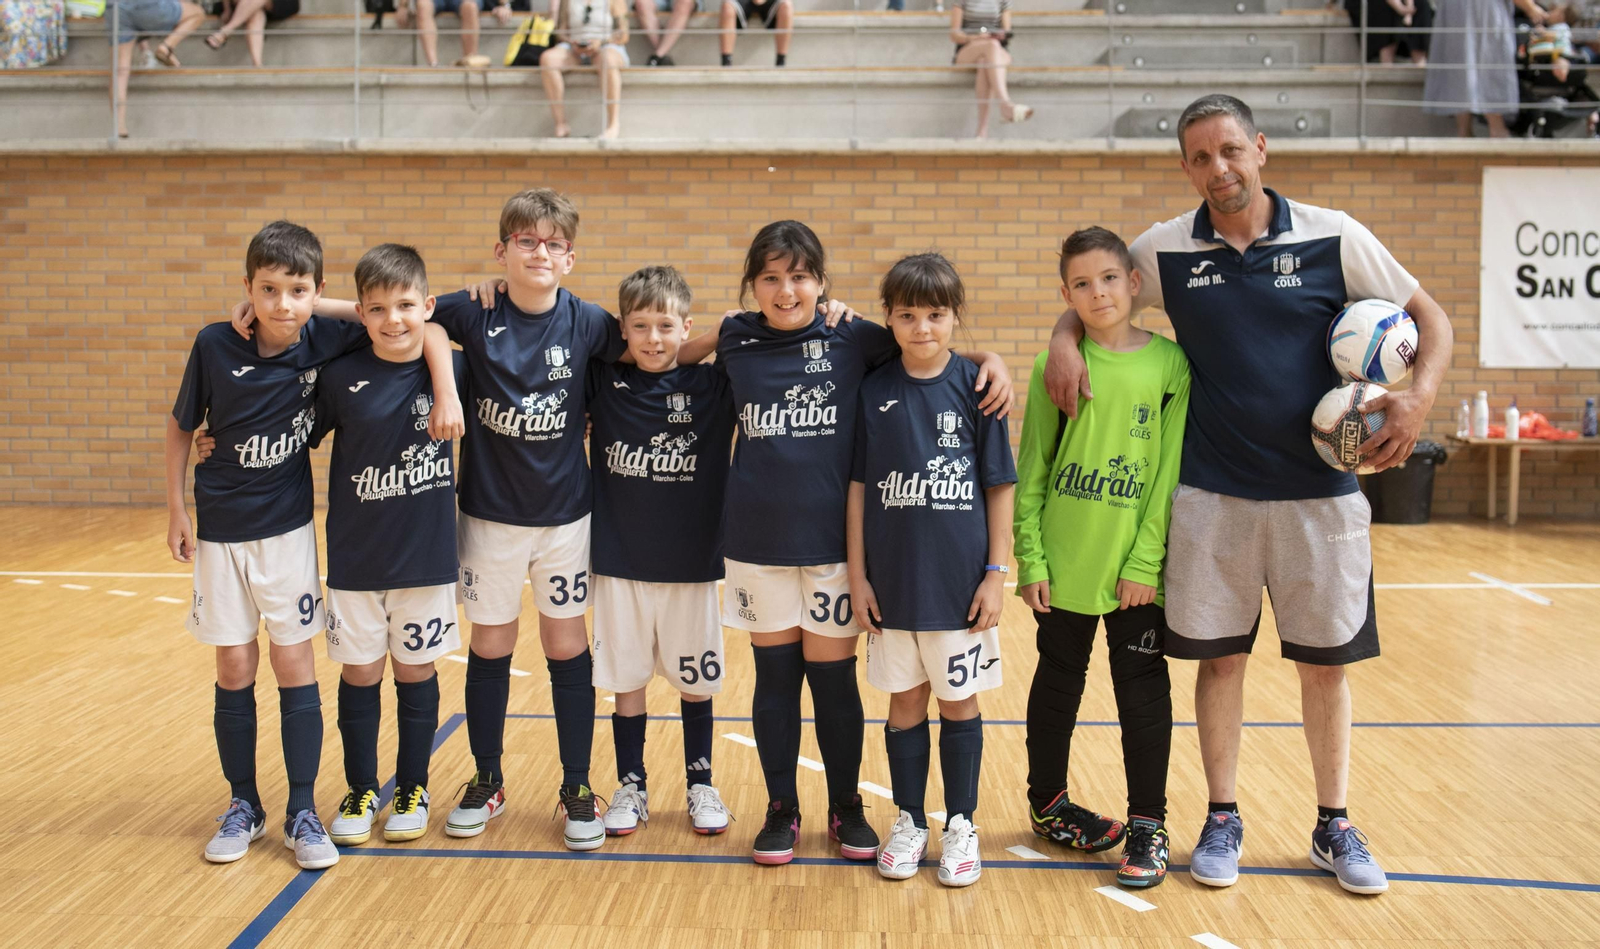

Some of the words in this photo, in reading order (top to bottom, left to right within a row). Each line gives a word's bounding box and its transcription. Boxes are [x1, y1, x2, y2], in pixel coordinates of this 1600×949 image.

[1187, 275, 1210, 288] JOAO
[1212, 274, 1225, 285] M.
[1274, 278, 1302, 288] COLES
[548, 369, 573, 381] COLES
[805, 362, 832, 374] COLES
[476, 398, 567, 432] Aldraba
[667, 414, 692, 423] COLES
[739, 401, 837, 435] Aldraba
[937, 437, 960, 448] COLES
[1130, 428, 1151, 440] COLES
[1344, 421, 1358, 464] MUNICH
[605, 441, 697, 473] Aldraba
[350, 455, 451, 497] Aldraba
[436, 479, 451, 488] Coles
[652, 474, 676, 482] Vilarchao
[877, 471, 974, 504] Aldraba
[932, 502, 956, 510] Vilarchao
[959, 502, 972, 510] Coles
[1327, 528, 1367, 542] CHICAGO
[549, 570, 588, 606] 35
[298, 593, 314, 625] 9
[738, 609, 757, 622] COLES
[810, 592, 853, 626] 30
[403, 617, 442, 651] 32
[679, 650, 721, 685] 56
[947, 643, 982, 687] 57
